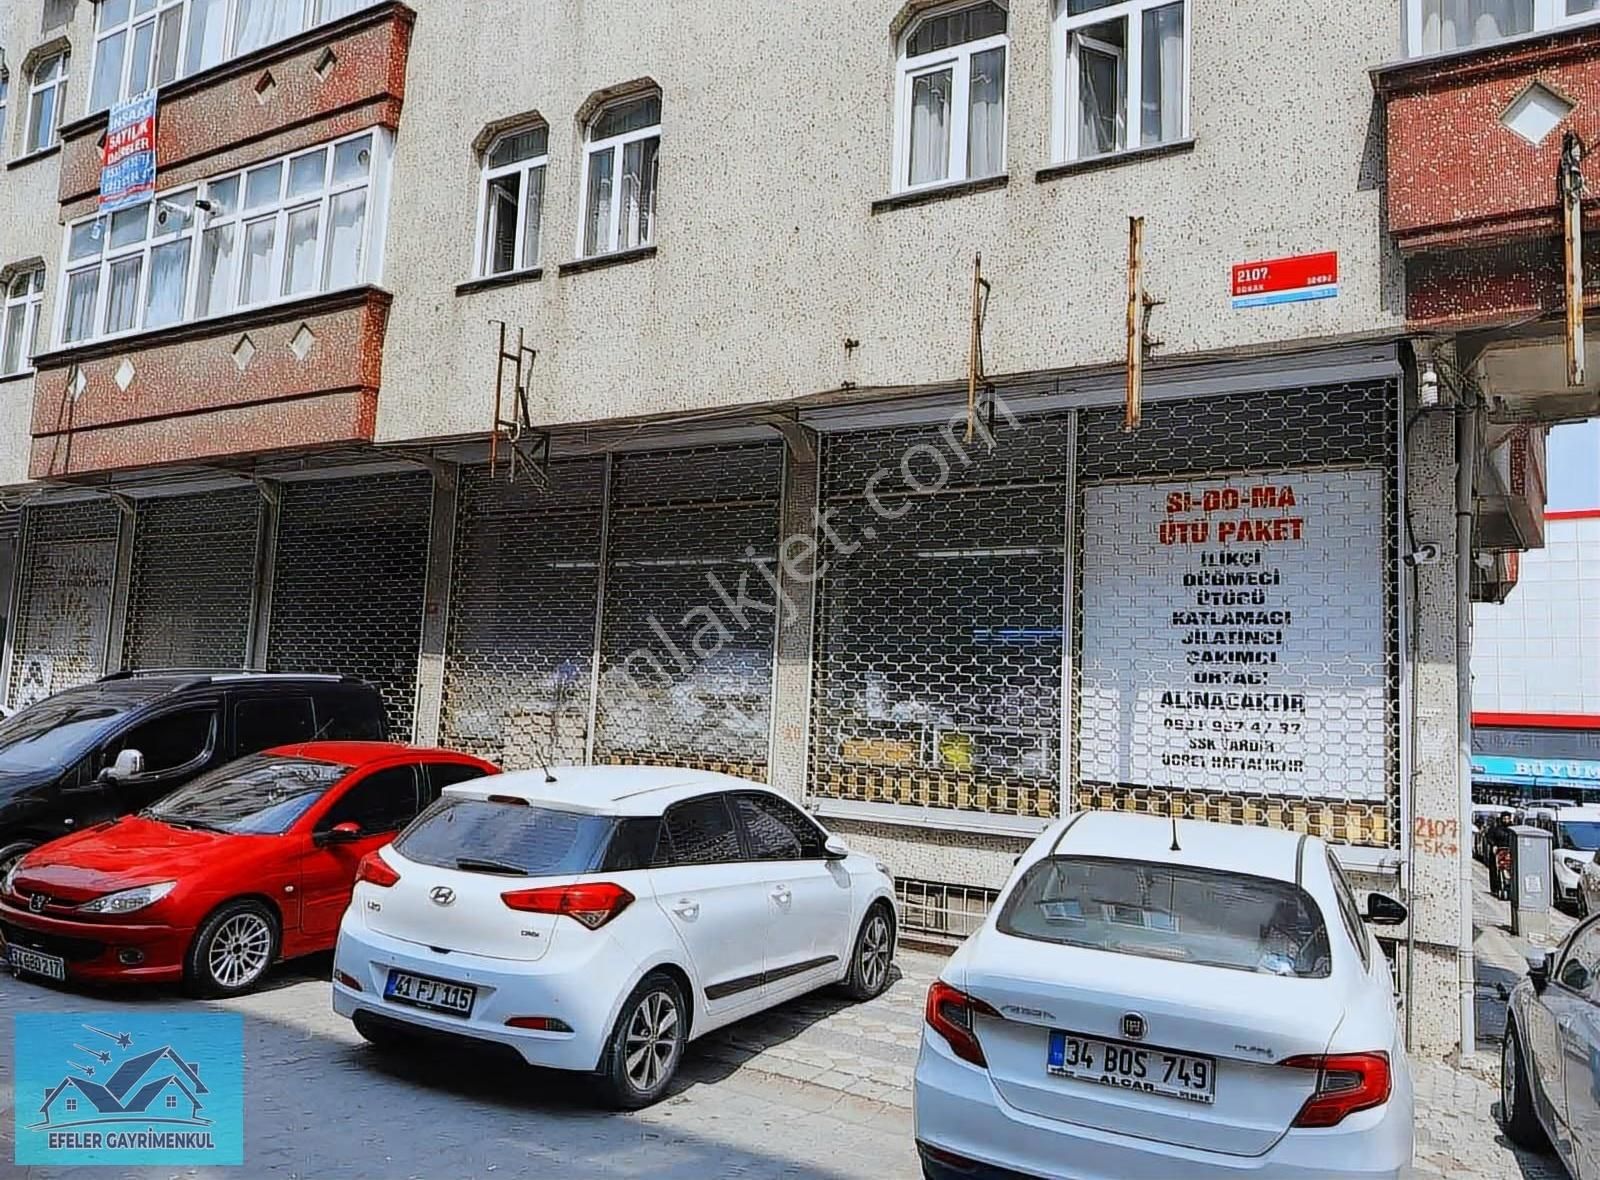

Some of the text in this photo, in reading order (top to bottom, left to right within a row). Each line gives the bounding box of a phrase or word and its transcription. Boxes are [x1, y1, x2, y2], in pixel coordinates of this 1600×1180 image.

[1218, 517, 1303, 542] PAKET
[1189, 737, 1216, 750] SSK
[1415, 816, 1457, 838] 2107
[396, 976, 470, 1009] 41 FJ 115
[1066, 1040, 1207, 1089] 34 BOS 749
